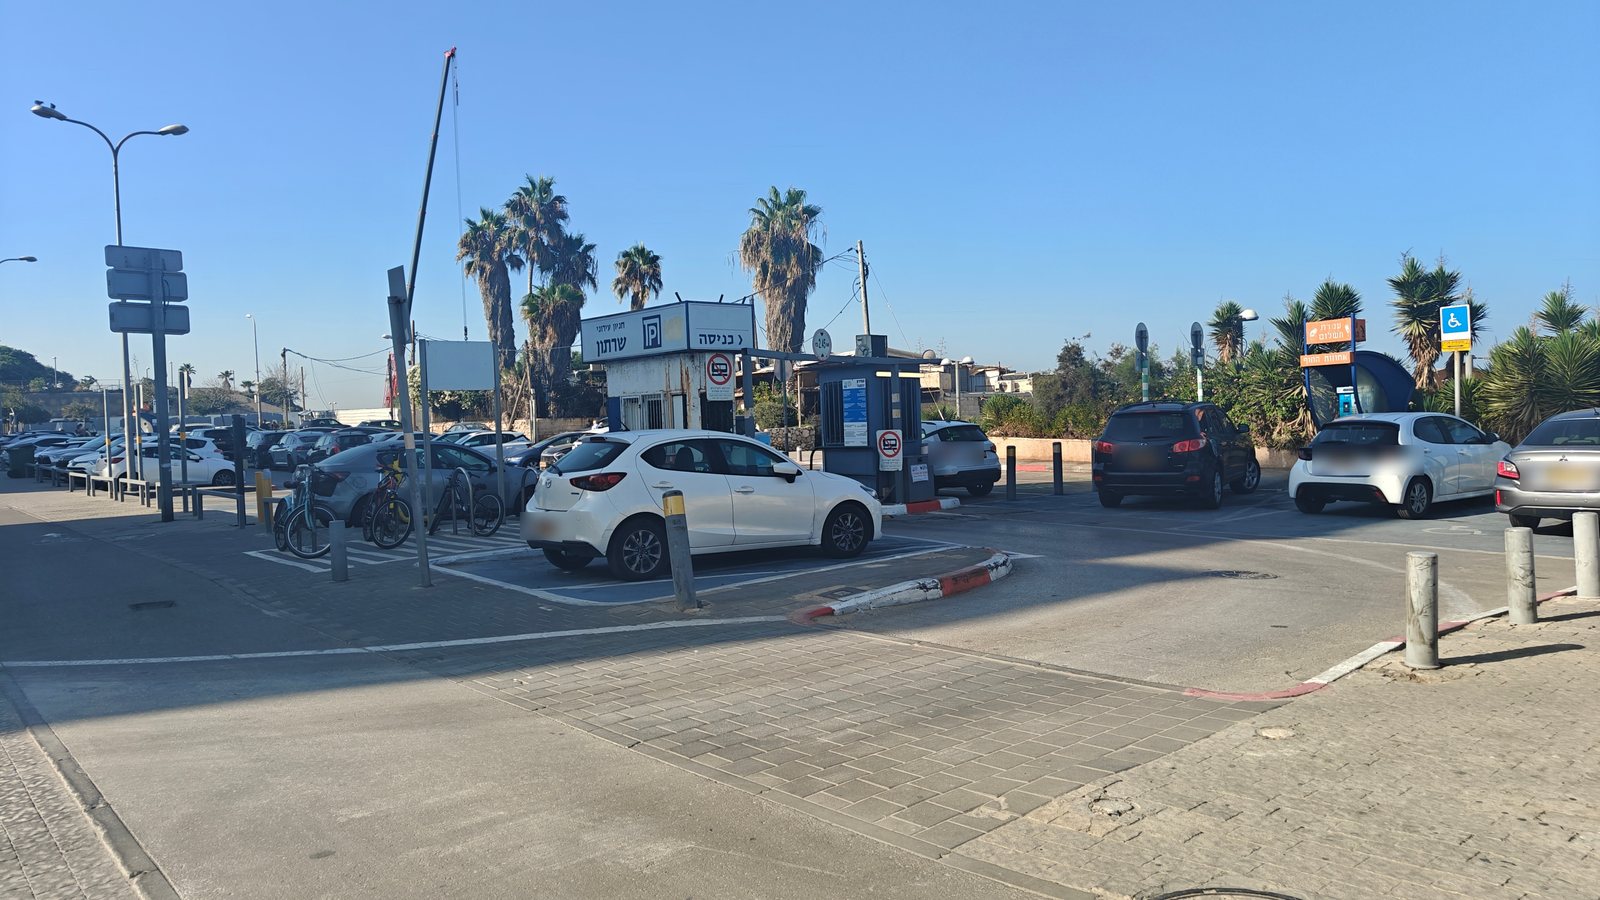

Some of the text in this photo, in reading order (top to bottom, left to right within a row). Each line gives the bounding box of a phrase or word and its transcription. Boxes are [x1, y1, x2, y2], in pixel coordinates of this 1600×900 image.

[612, 321, 626, 332] חניון
[698, 333, 734, 345] כניסה
[596, 336, 627, 358] שרתון
[1303, 356, 1320, 364] החוף
